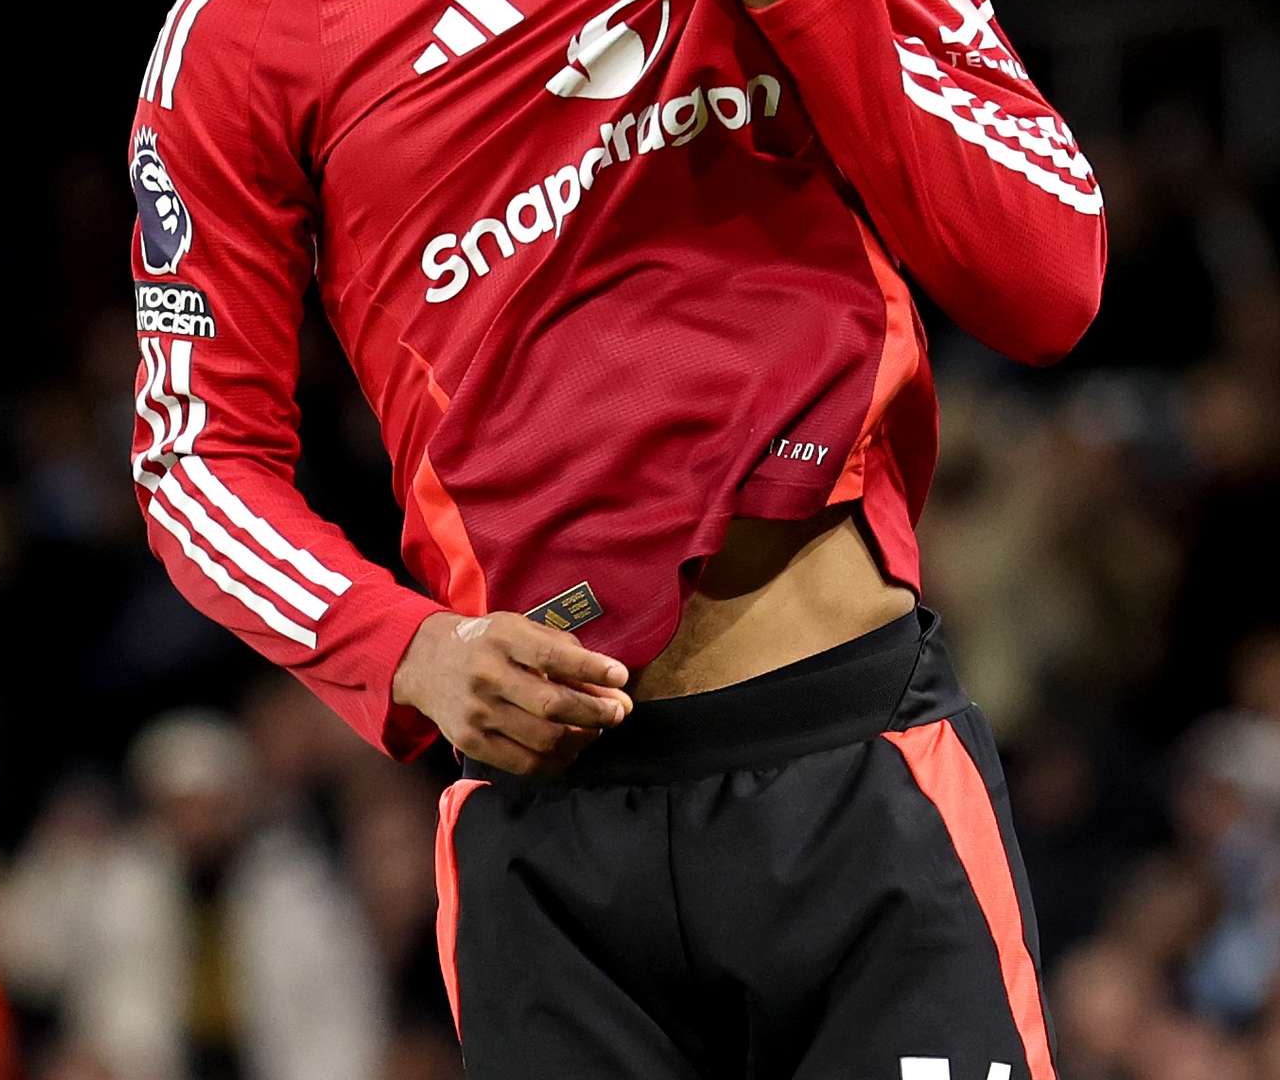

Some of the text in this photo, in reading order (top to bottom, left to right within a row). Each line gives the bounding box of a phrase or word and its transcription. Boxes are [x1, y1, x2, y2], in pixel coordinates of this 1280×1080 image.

[421, 75, 781, 304] Snapdragon
[139, 286, 205, 314] room
[769, 438, 829, 466] T.RDY
